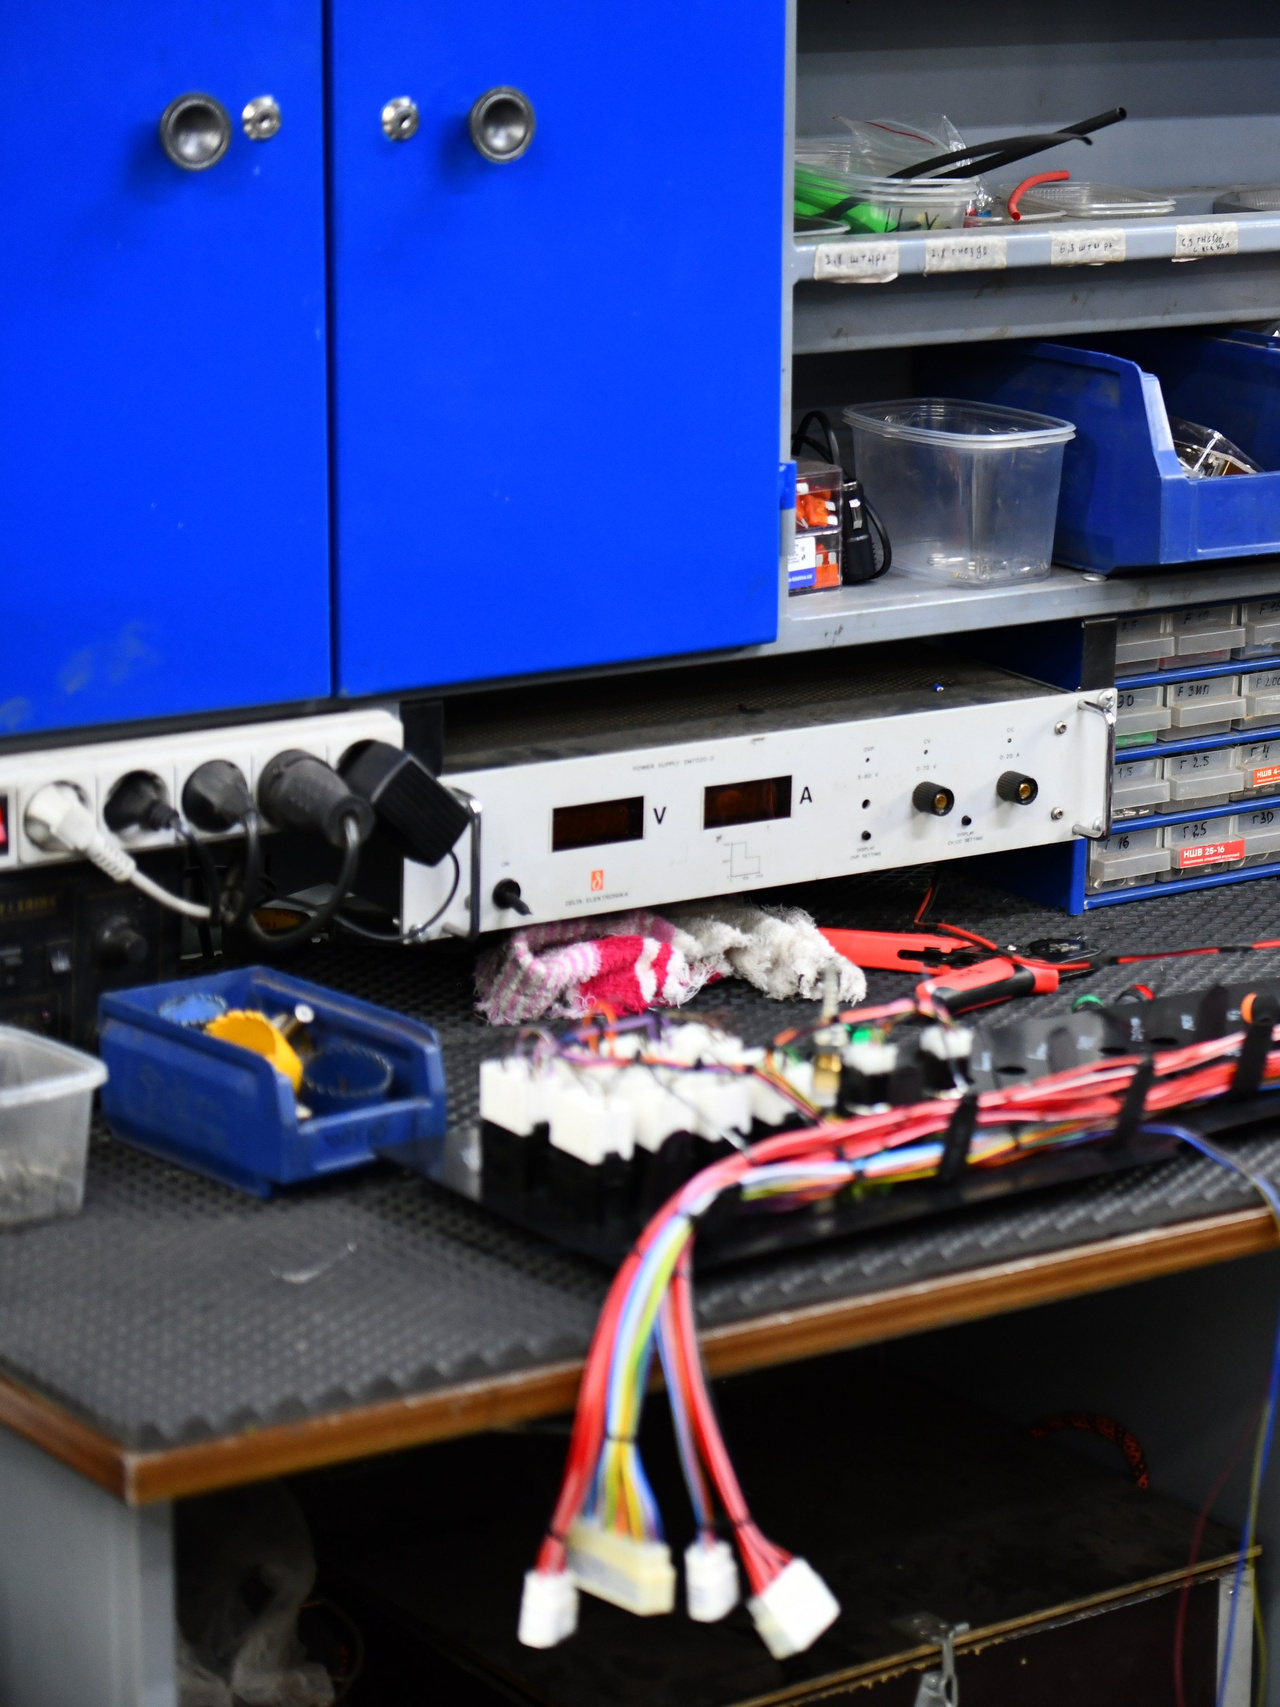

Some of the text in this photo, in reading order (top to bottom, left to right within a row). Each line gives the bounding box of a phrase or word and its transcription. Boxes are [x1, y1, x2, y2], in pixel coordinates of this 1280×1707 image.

[1256, 769, 1272, 779] НШВ
[799, 786, 813, 804] A
[653, 806, 667, 825] V
[1183, 848, 1203, 859] НШВ
[1204, 845, 1225, 856] 25-16
